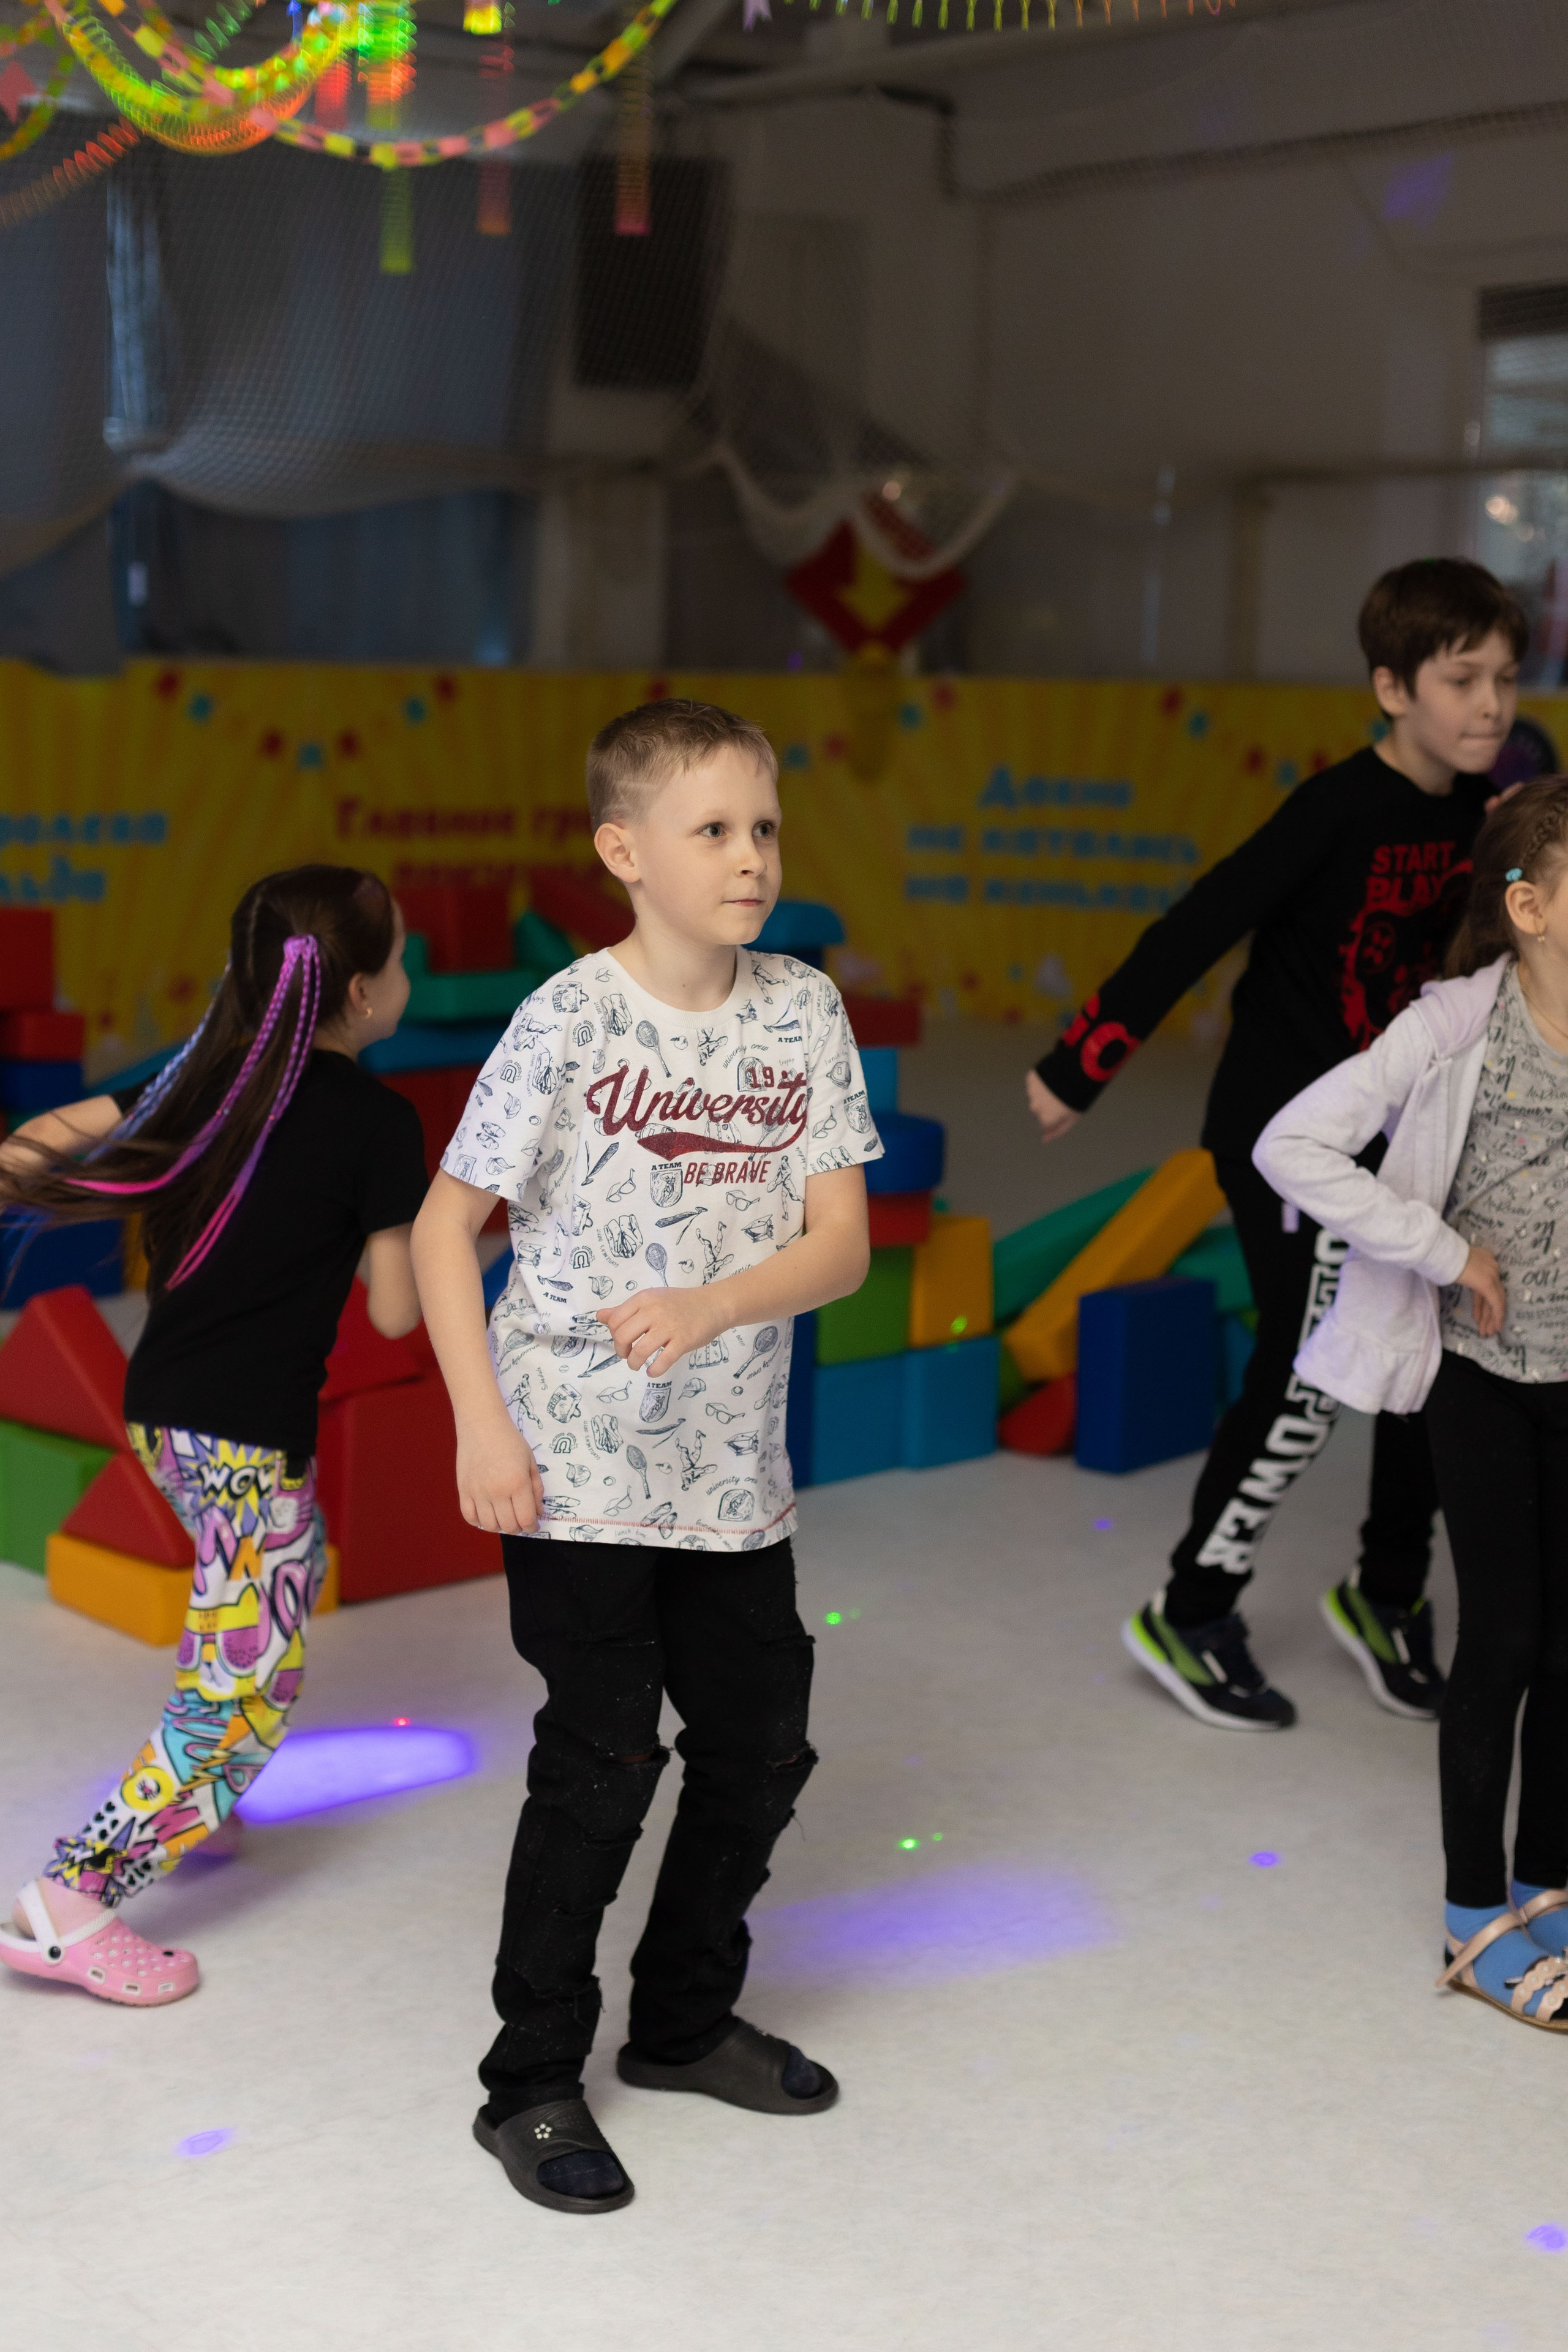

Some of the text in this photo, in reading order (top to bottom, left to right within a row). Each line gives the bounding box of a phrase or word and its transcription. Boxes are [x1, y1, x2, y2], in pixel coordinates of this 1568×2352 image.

[1371, 841, 1455, 874] START
[1365, 876, 1443, 907] PLAY
[722, 1045, 747, 1069] university
[778, 1058, 795, 1066] trophy
[586, 1065, 807, 1137] University
[848, 1090, 865, 1102] TEAM
[660, 1161, 682, 1170] TEAM
[684, 1161, 772, 1184] BE BRAVE
[549, 1294, 567, 1303] TEAM
[706, 1476, 741, 1496] university
[614, 1527, 631, 1537] lunch
